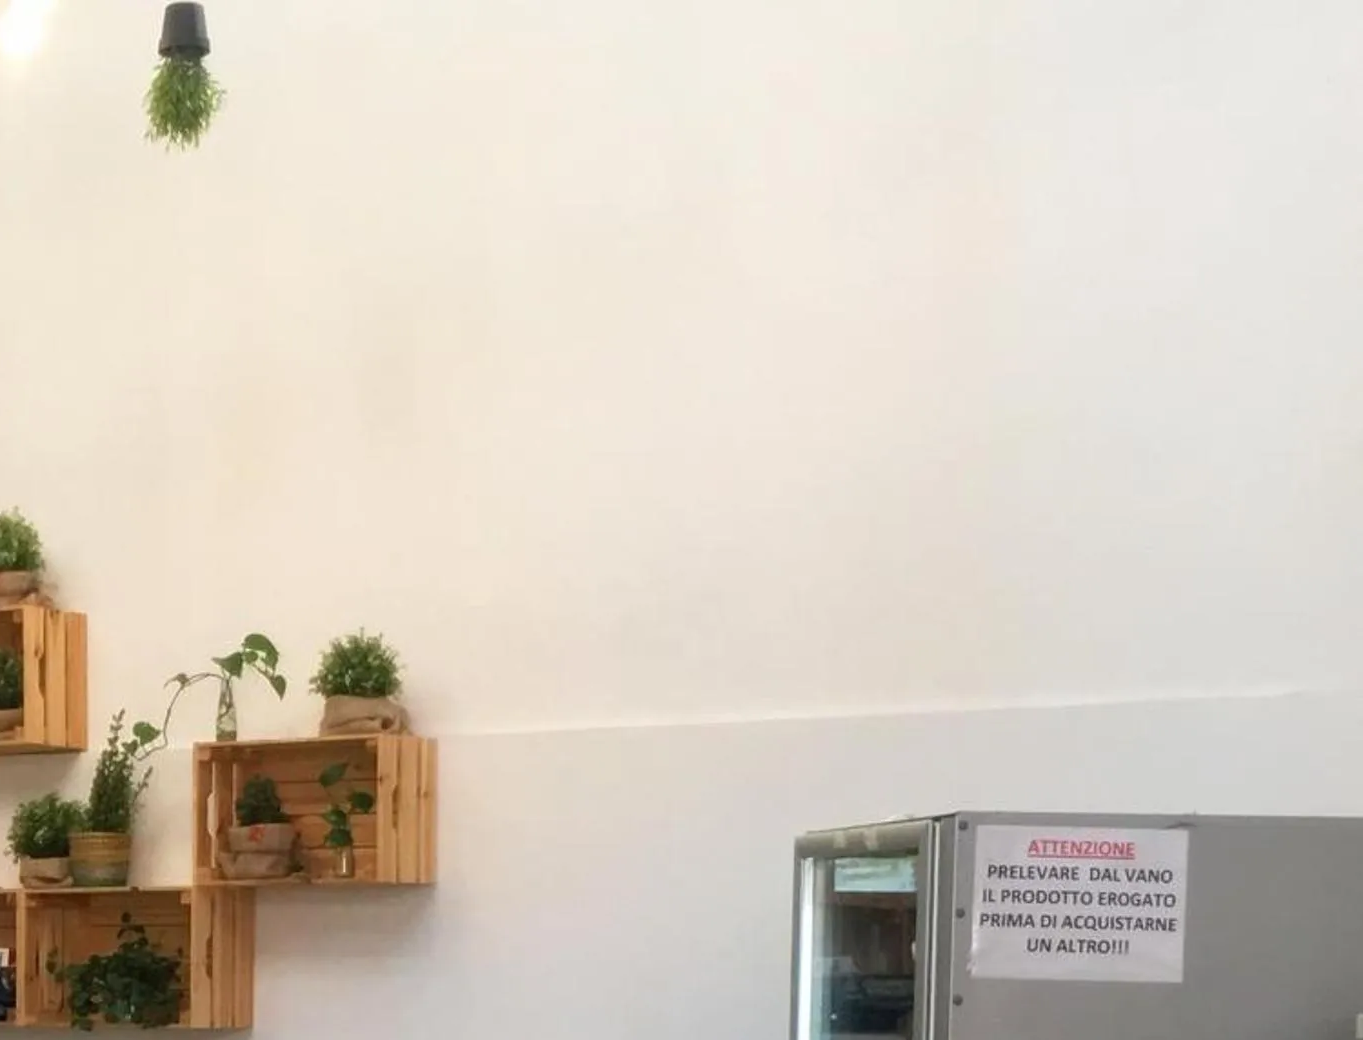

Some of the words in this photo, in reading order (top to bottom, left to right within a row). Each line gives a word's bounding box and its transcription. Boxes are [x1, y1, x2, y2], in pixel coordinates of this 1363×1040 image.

[1028, 839, 1135, 857] ATTENZIONE
[987, 864, 1080, 881] PRELEVARE
[1089, 867, 1121, 883] DAL
[1125, 868, 1173, 884] VANO
[983, 889, 995, 903] IL
[1000, 889, 1093, 906] PRODOTTO
[1098, 892, 1177, 908] EROGATO
[980, 913, 1035, 929] PRIMA
[1040, 915, 1057, 929] DI
[1061, 915, 1178, 932] ACQUISTARNE
[1027, 938, 1052, 953] UN
[1056, 939, 1130, 955] ALTRO!!!
